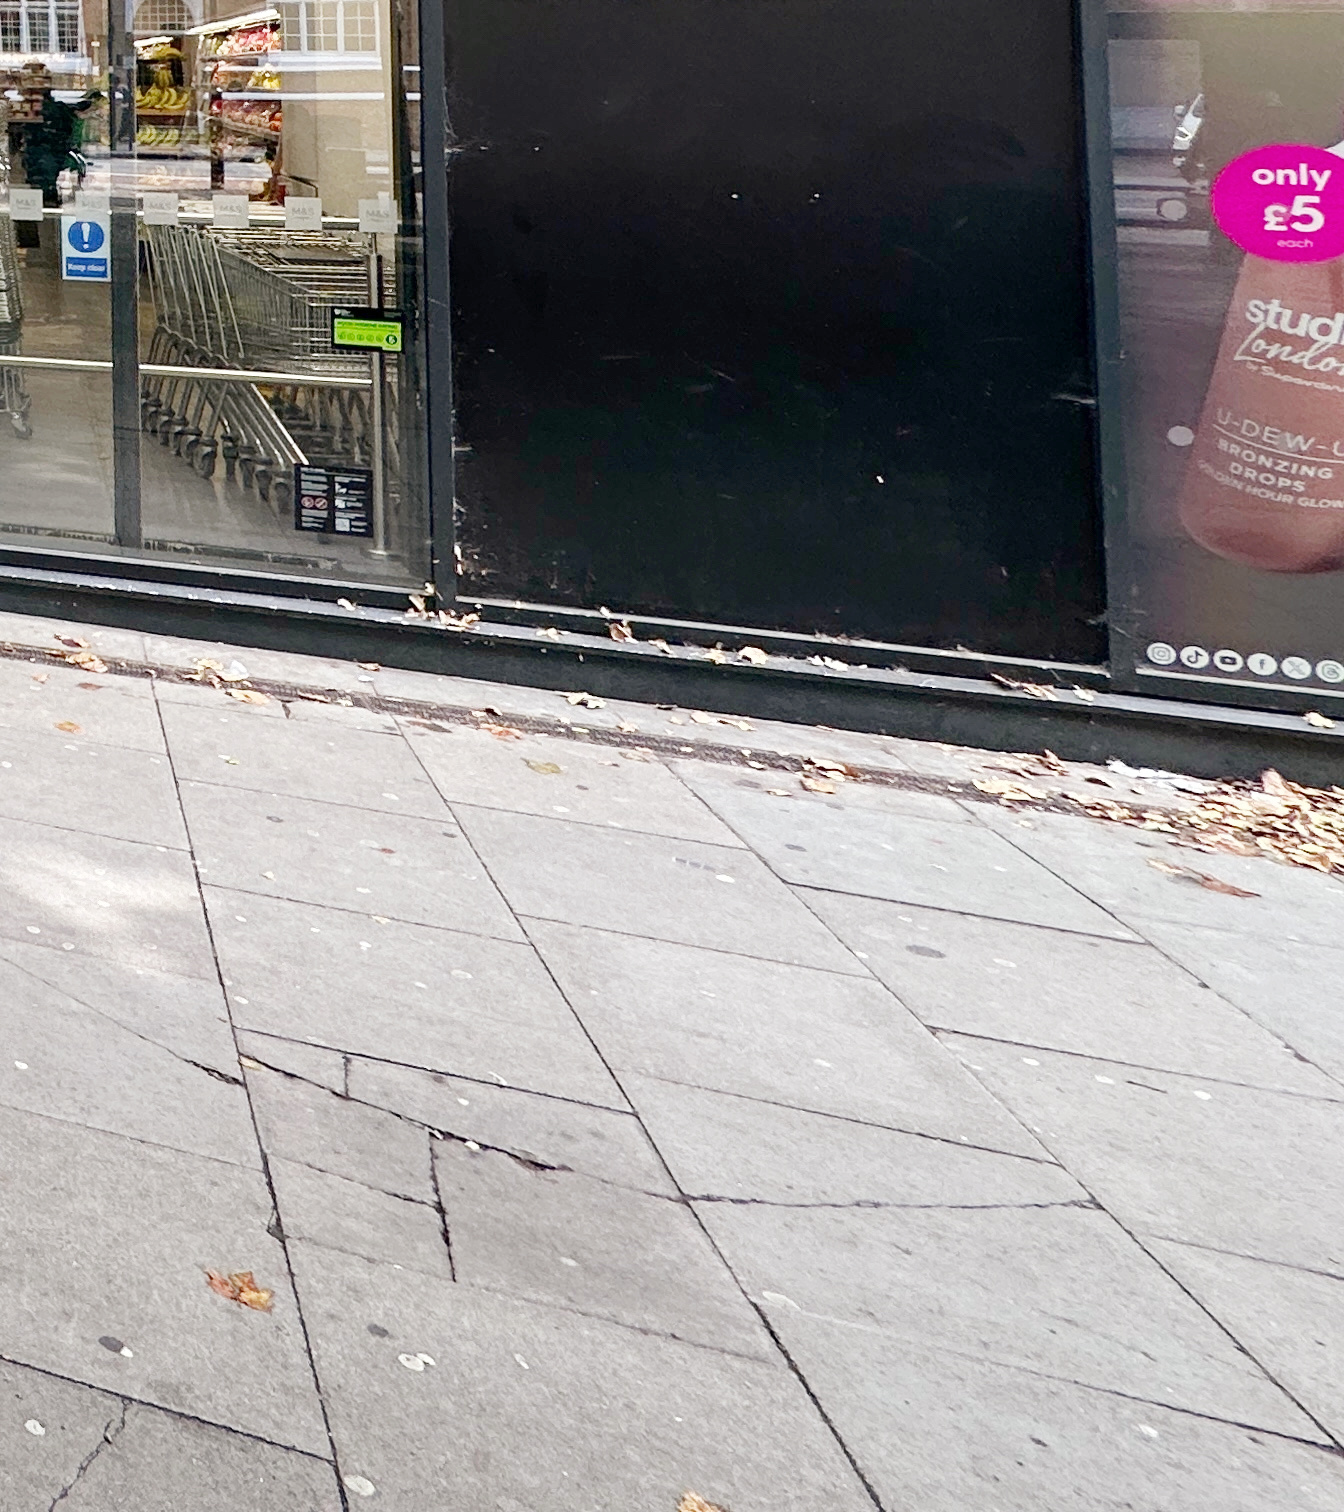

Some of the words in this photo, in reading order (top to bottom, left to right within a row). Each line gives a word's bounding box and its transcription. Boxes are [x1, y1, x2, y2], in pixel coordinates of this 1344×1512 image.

[1251, 162, 1333, 192] only
[1263, 194, 1326, 233] £5
[1276, 238, 1314, 249] each
[67, 263, 86, 275] Keep
[1244, 298, 1344, 345] stud
[1217, 437, 1334, 480] BRONZING
[1229, 461, 1307, 493] DROPS
[1245, 485, 1295, 504] HOUR
